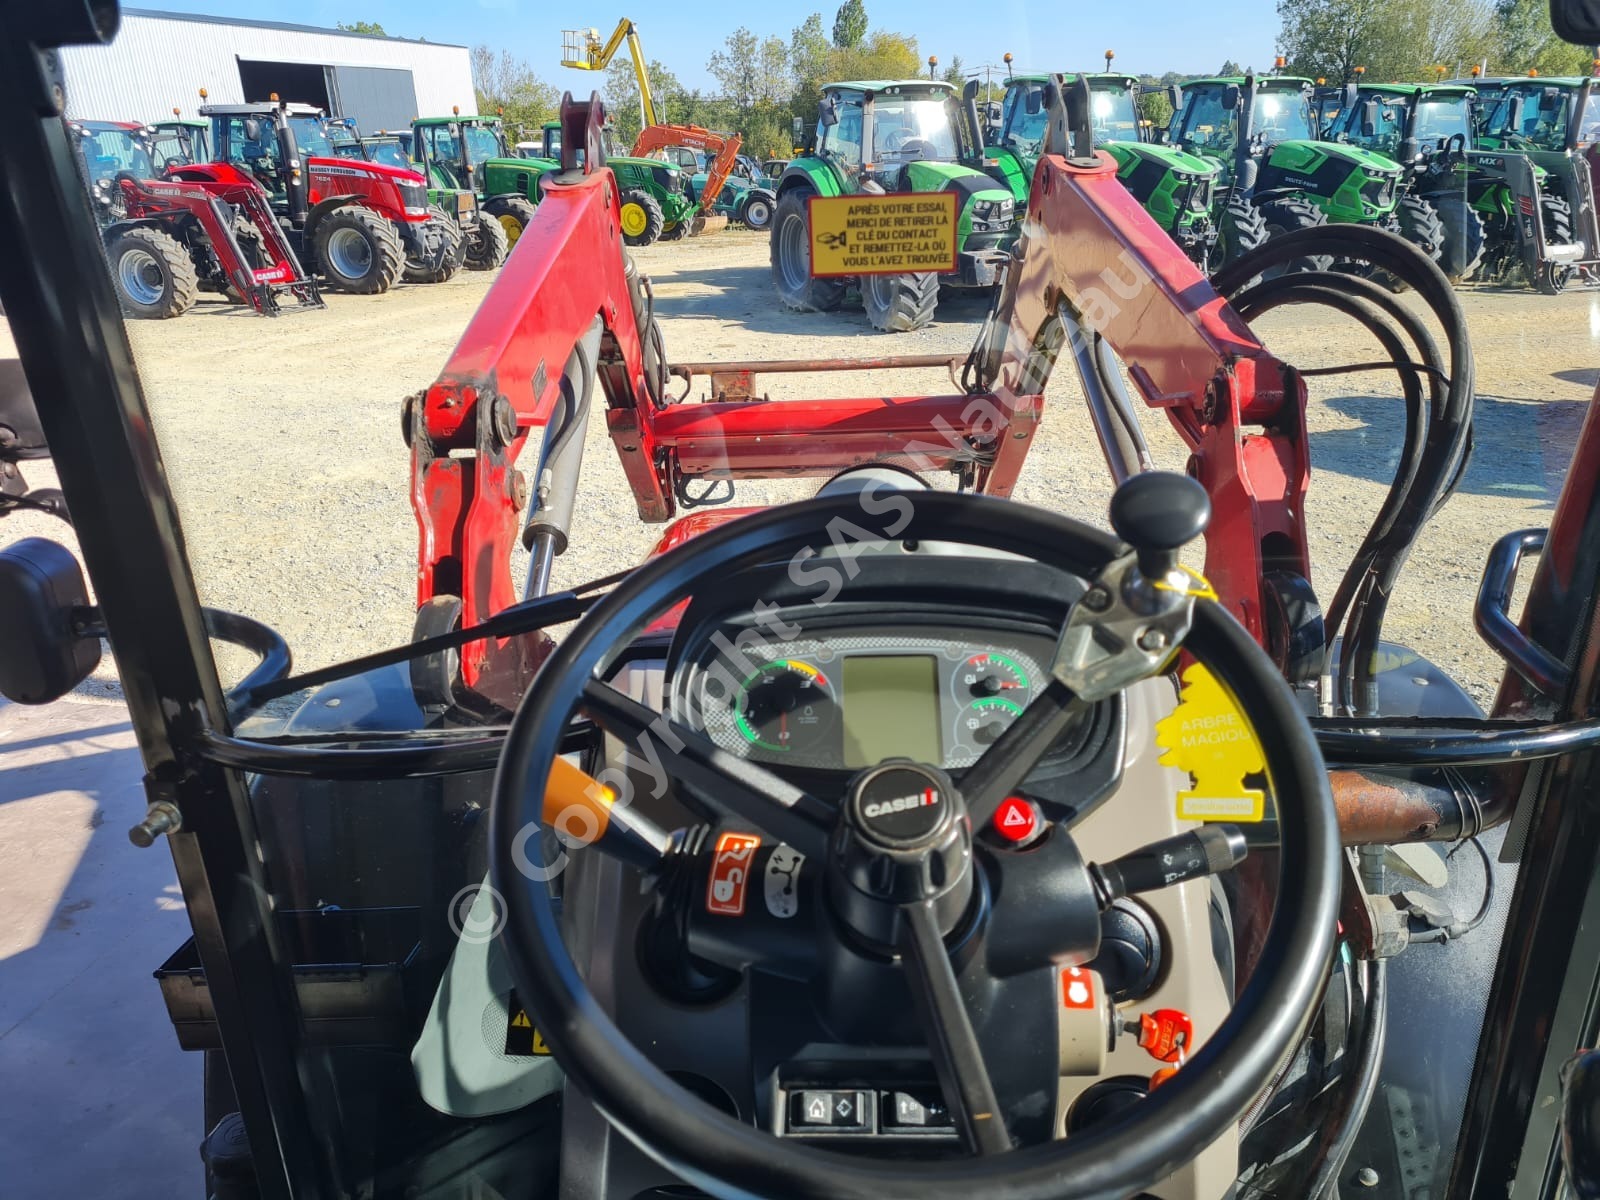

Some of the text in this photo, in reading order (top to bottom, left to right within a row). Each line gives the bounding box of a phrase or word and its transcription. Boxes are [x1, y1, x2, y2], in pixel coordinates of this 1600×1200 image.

[1479, 157, 1496, 165] MX
[331, 167, 355, 175] FERGUSON
[848, 202, 947, 215] APRÈS VOTRE ESSAI,
[847, 215, 948, 228] MERCI DE RETIRER LA
[856, 229, 938, 241] CLÉ DU CONTACT
[849, 244, 860, 253] ET
[864, 241, 929, 252] REMETTEZ-LA
[842, 256, 868, 266] VOUS
[871, 255, 903, 265] L'AVEZ
[1182, 714, 1240, 732] ARBRE
[864, 795, 919, 818] CASE
